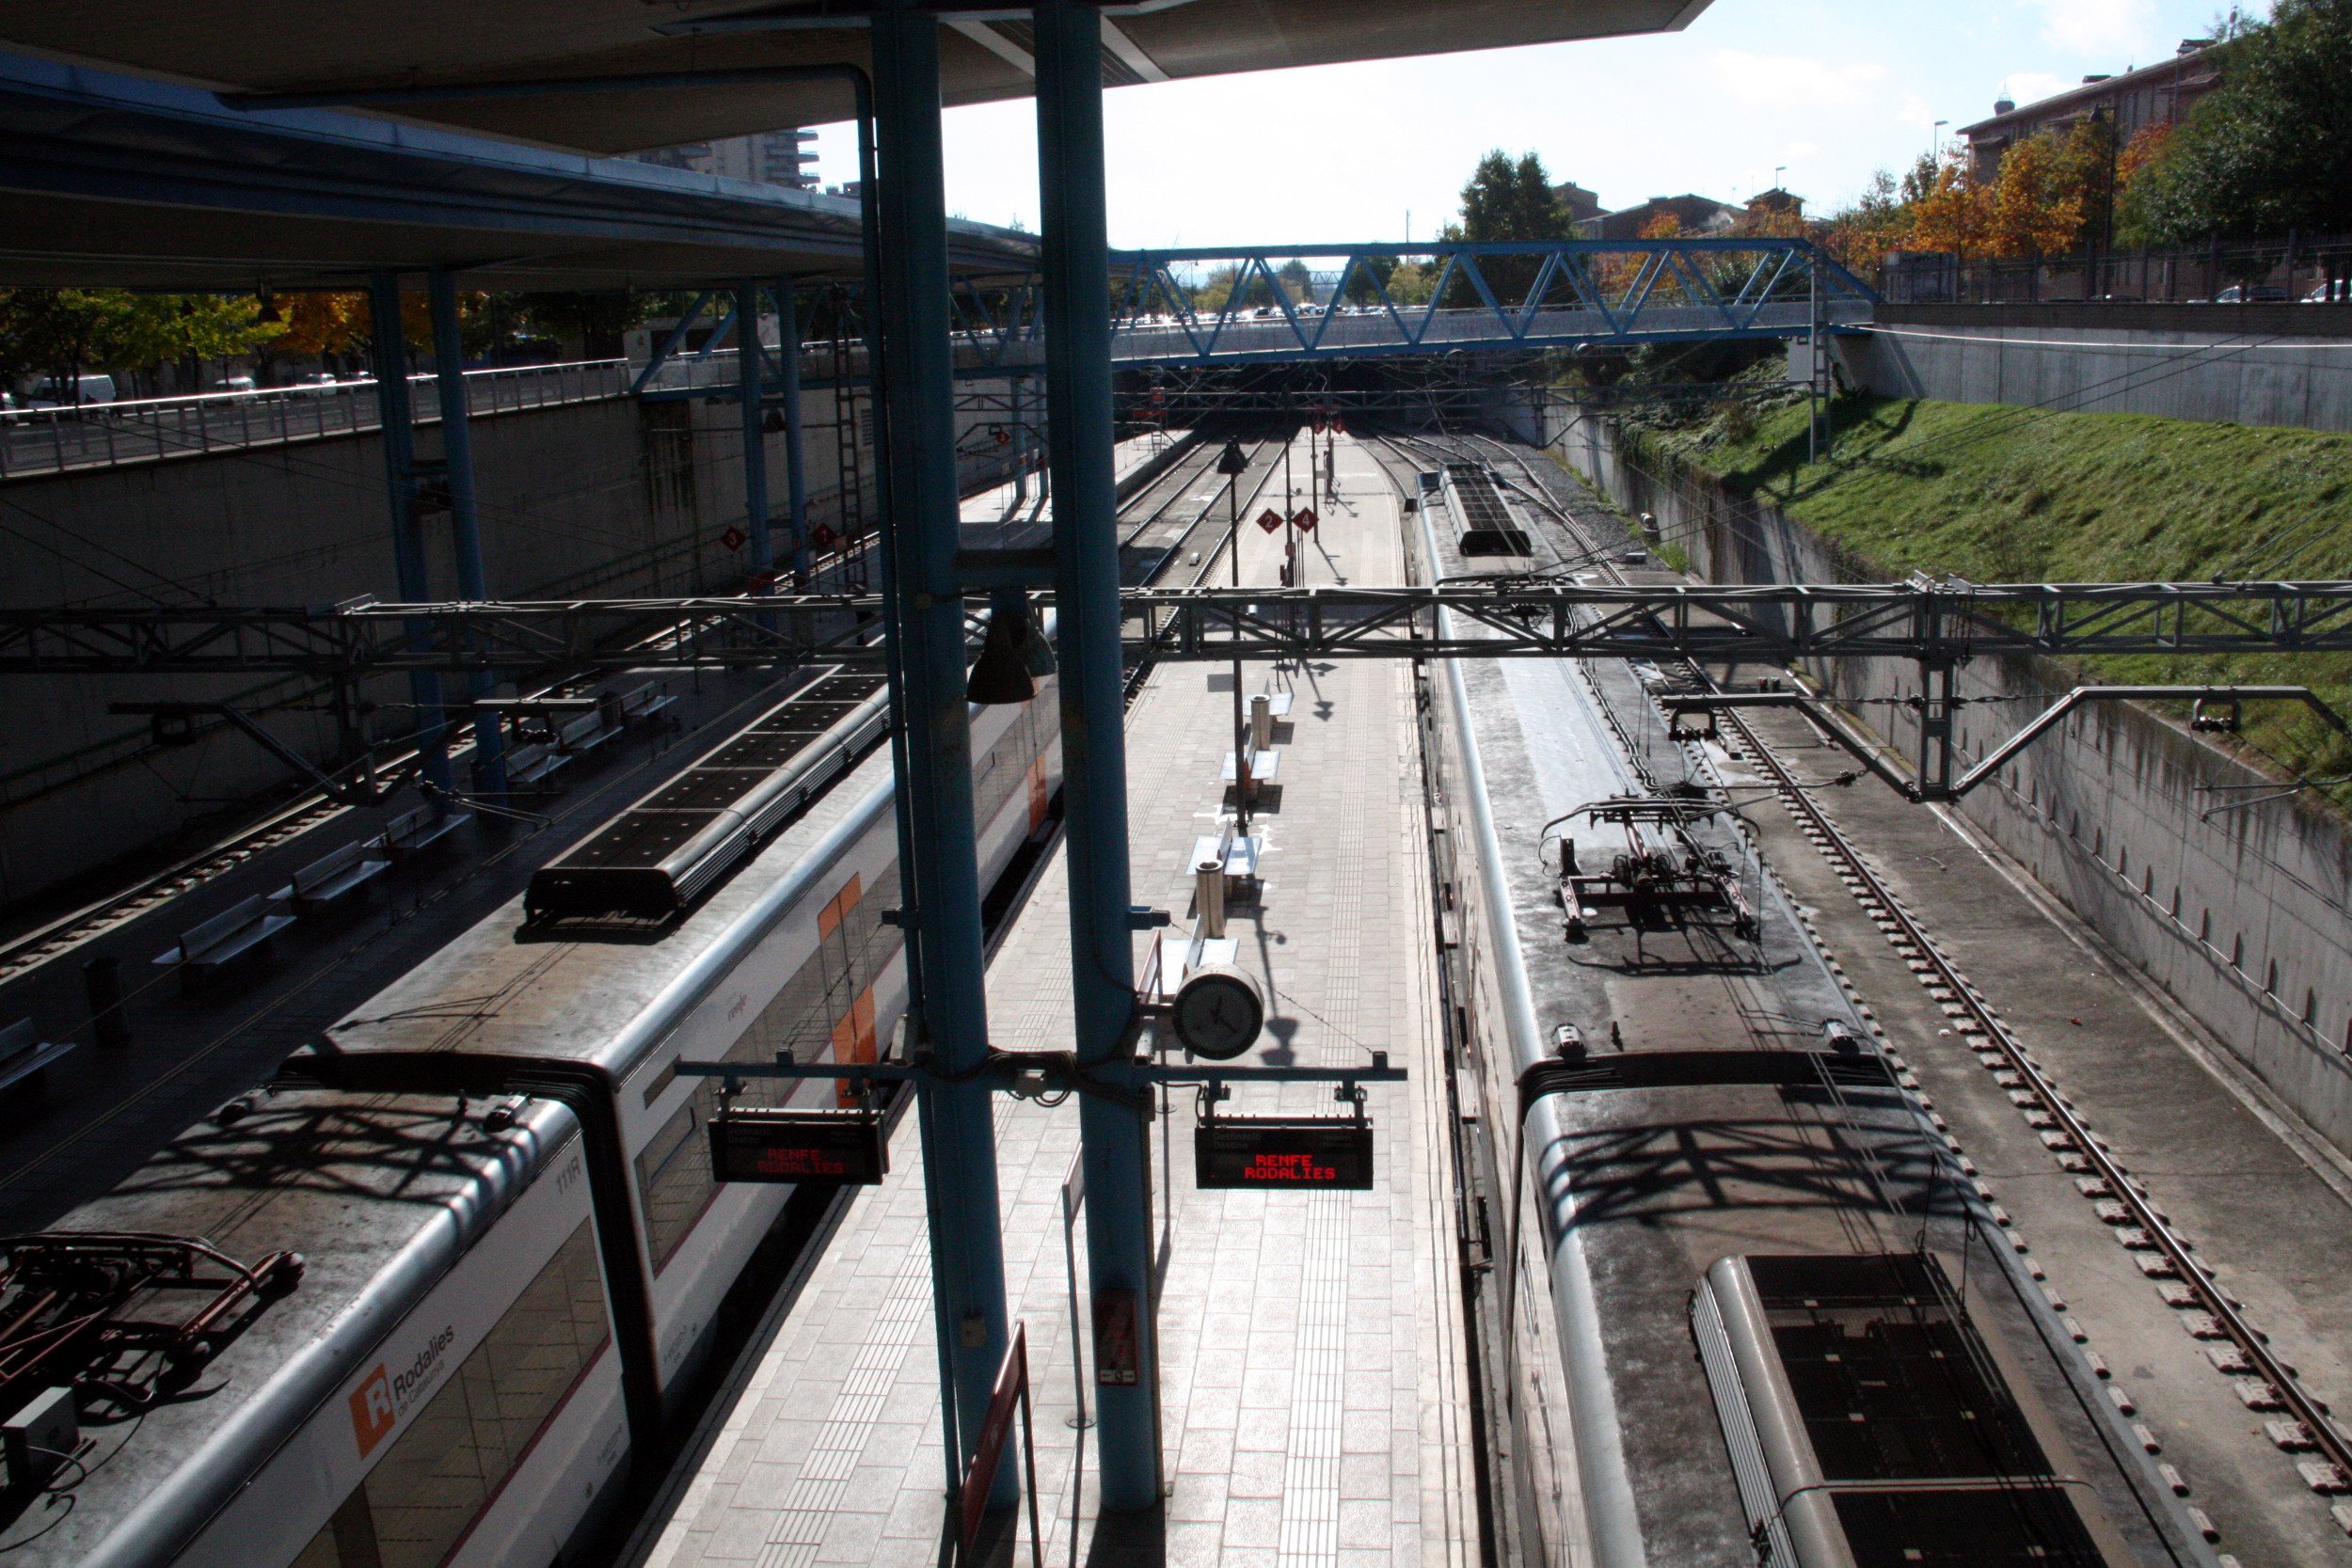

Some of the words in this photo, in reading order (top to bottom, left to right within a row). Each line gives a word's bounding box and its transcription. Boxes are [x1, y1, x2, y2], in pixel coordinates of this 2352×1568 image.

[1264, 515, 1273, 528] 2
[1302, 515, 1310, 526] 4
[729, 532, 738, 546] 3
[767, 1148, 821, 1161] RENFE
[1254, 1155, 1313, 1167] RENFE
[757, 1160, 845, 1174] RODALIES
[1244, 1167, 1337, 1180] RODALIES
[393, 1324, 454, 1402] Rodalies
